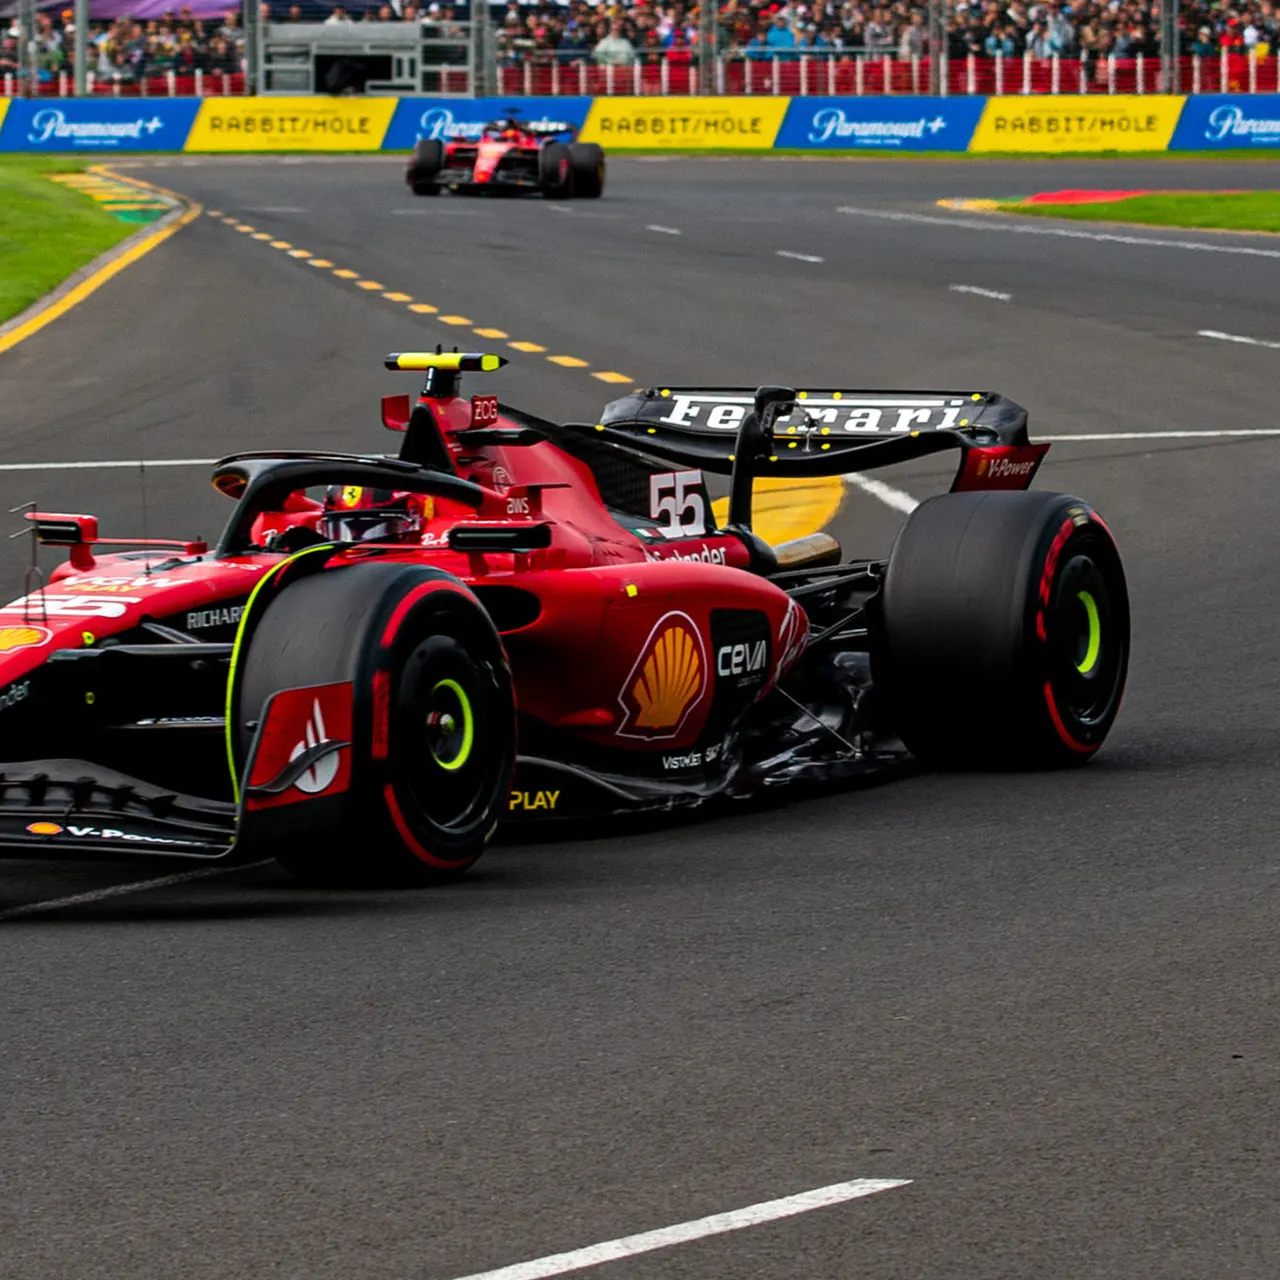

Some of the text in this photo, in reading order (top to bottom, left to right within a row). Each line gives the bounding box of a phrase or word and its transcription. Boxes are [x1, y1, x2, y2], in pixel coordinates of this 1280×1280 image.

[28, 108, 163, 144] Paramount+
[808, 108, 945, 143] Paramount+
[474, 398, 497, 420] ZCG
[660, 395, 964, 432] Ferari
[650, 469, 706, 538] 55
[63, 577, 194, 588] VGW
[509, 790, 560, 810] PLAY
